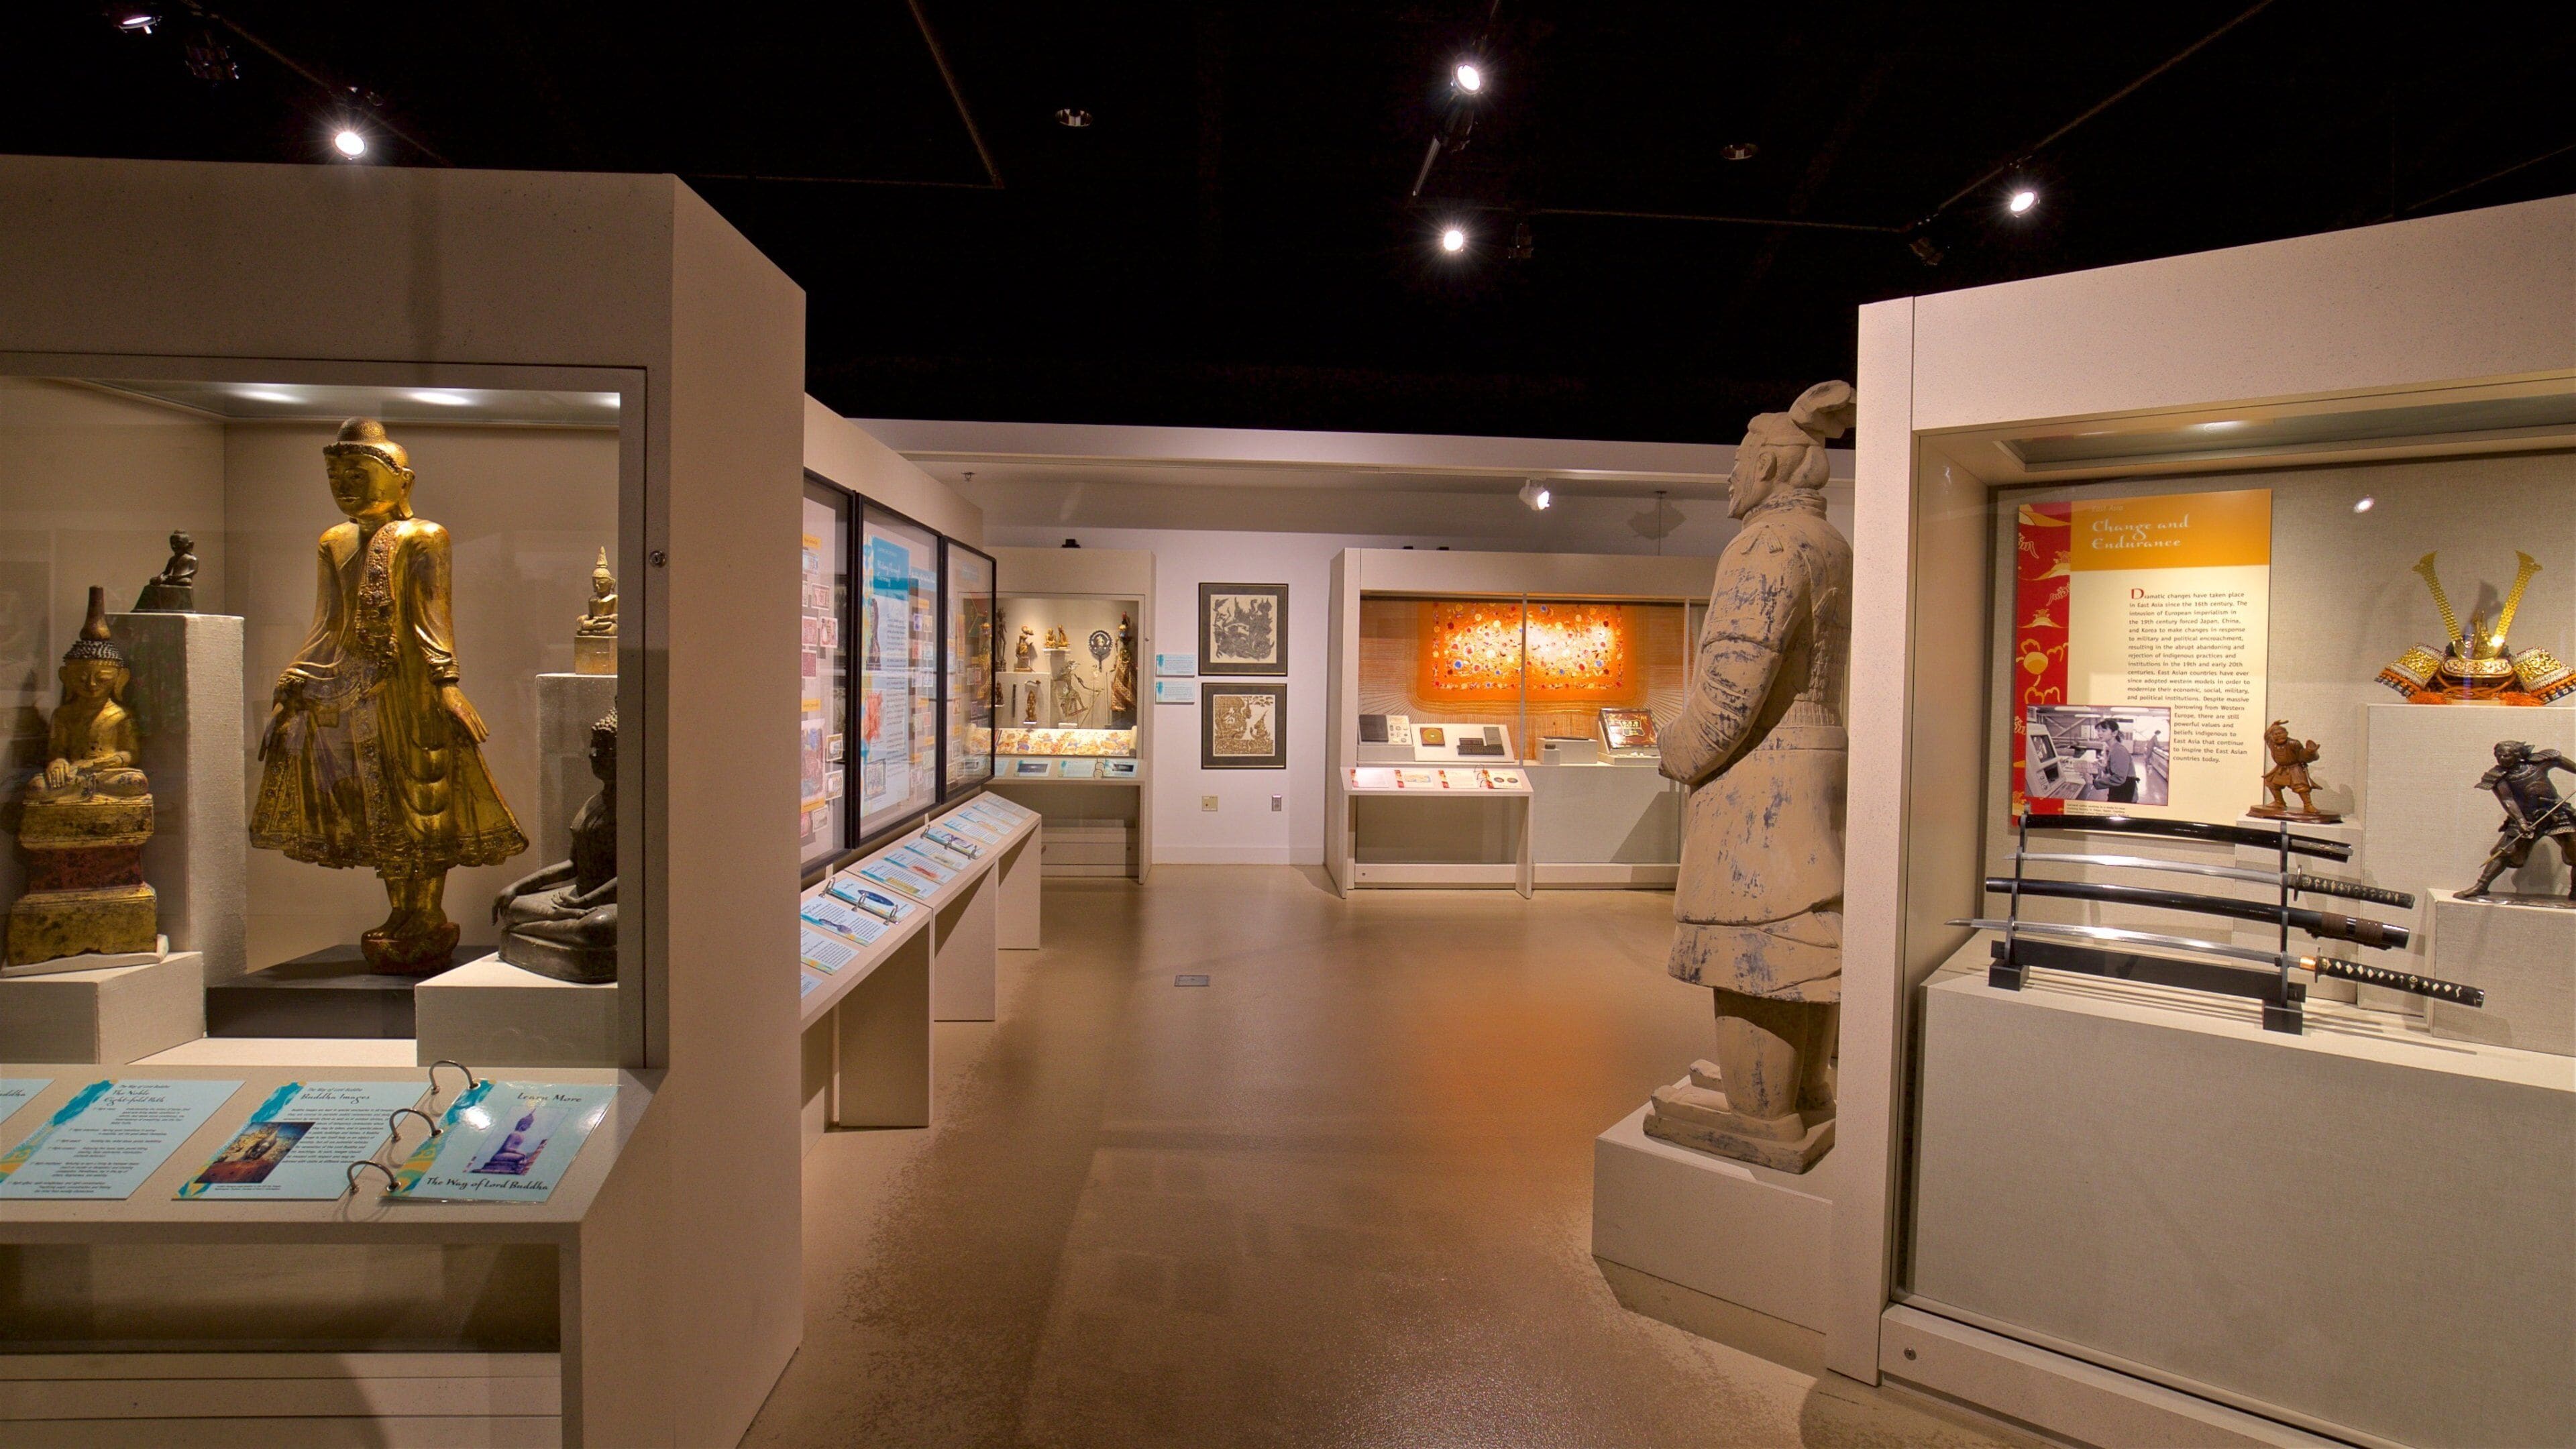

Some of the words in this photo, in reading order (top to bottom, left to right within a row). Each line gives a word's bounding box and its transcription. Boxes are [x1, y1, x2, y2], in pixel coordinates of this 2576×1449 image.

[2092, 519, 2151, 541] Change
[2158, 514, 2190, 529] and
[2092, 535, 2181, 549] Endurance
[2131, 588, 2165, 599] Dramatic
[339, 1093, 370, 1104] Images
[427, 1177, 443, 1185] The
[446, 1178, 468, 1189] Way
[471, 1178, 487, 1190] of
[484, 1180, 509, 1189] Lord
[509, 1181, 548, 1190] Buddha
